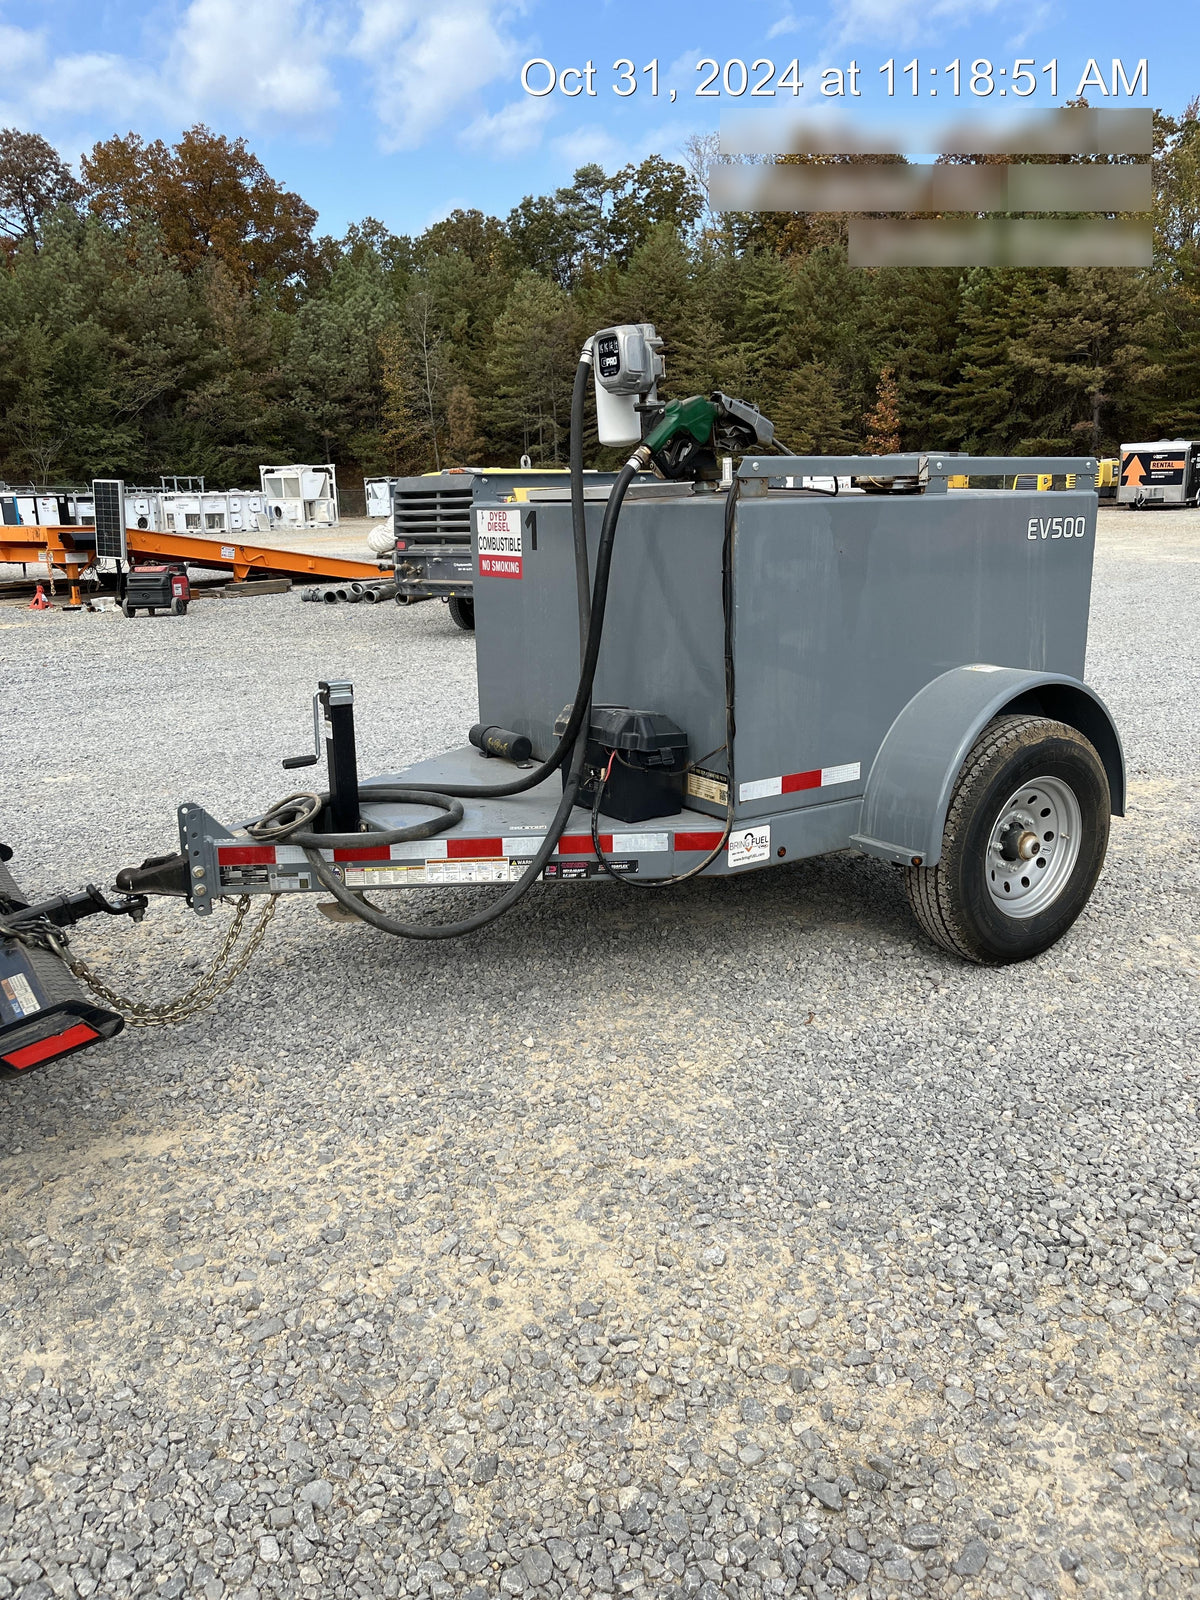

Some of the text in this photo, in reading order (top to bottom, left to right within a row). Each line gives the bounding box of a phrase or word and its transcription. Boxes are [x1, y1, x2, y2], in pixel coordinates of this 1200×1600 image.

[490, 511, 507, 521] DYED
[487, 522, 510, 532] DIESEL
[525, 511, 537, 550] 1
[1027, 516, 1086, 540] EV500
[478, 536, 522, 552] COMBUSTIBLE
[482, 560, 520, 574] NO SMOKING
[729, 839, 750, 851] BRING
[751, 835, 769, 846] FUEL
